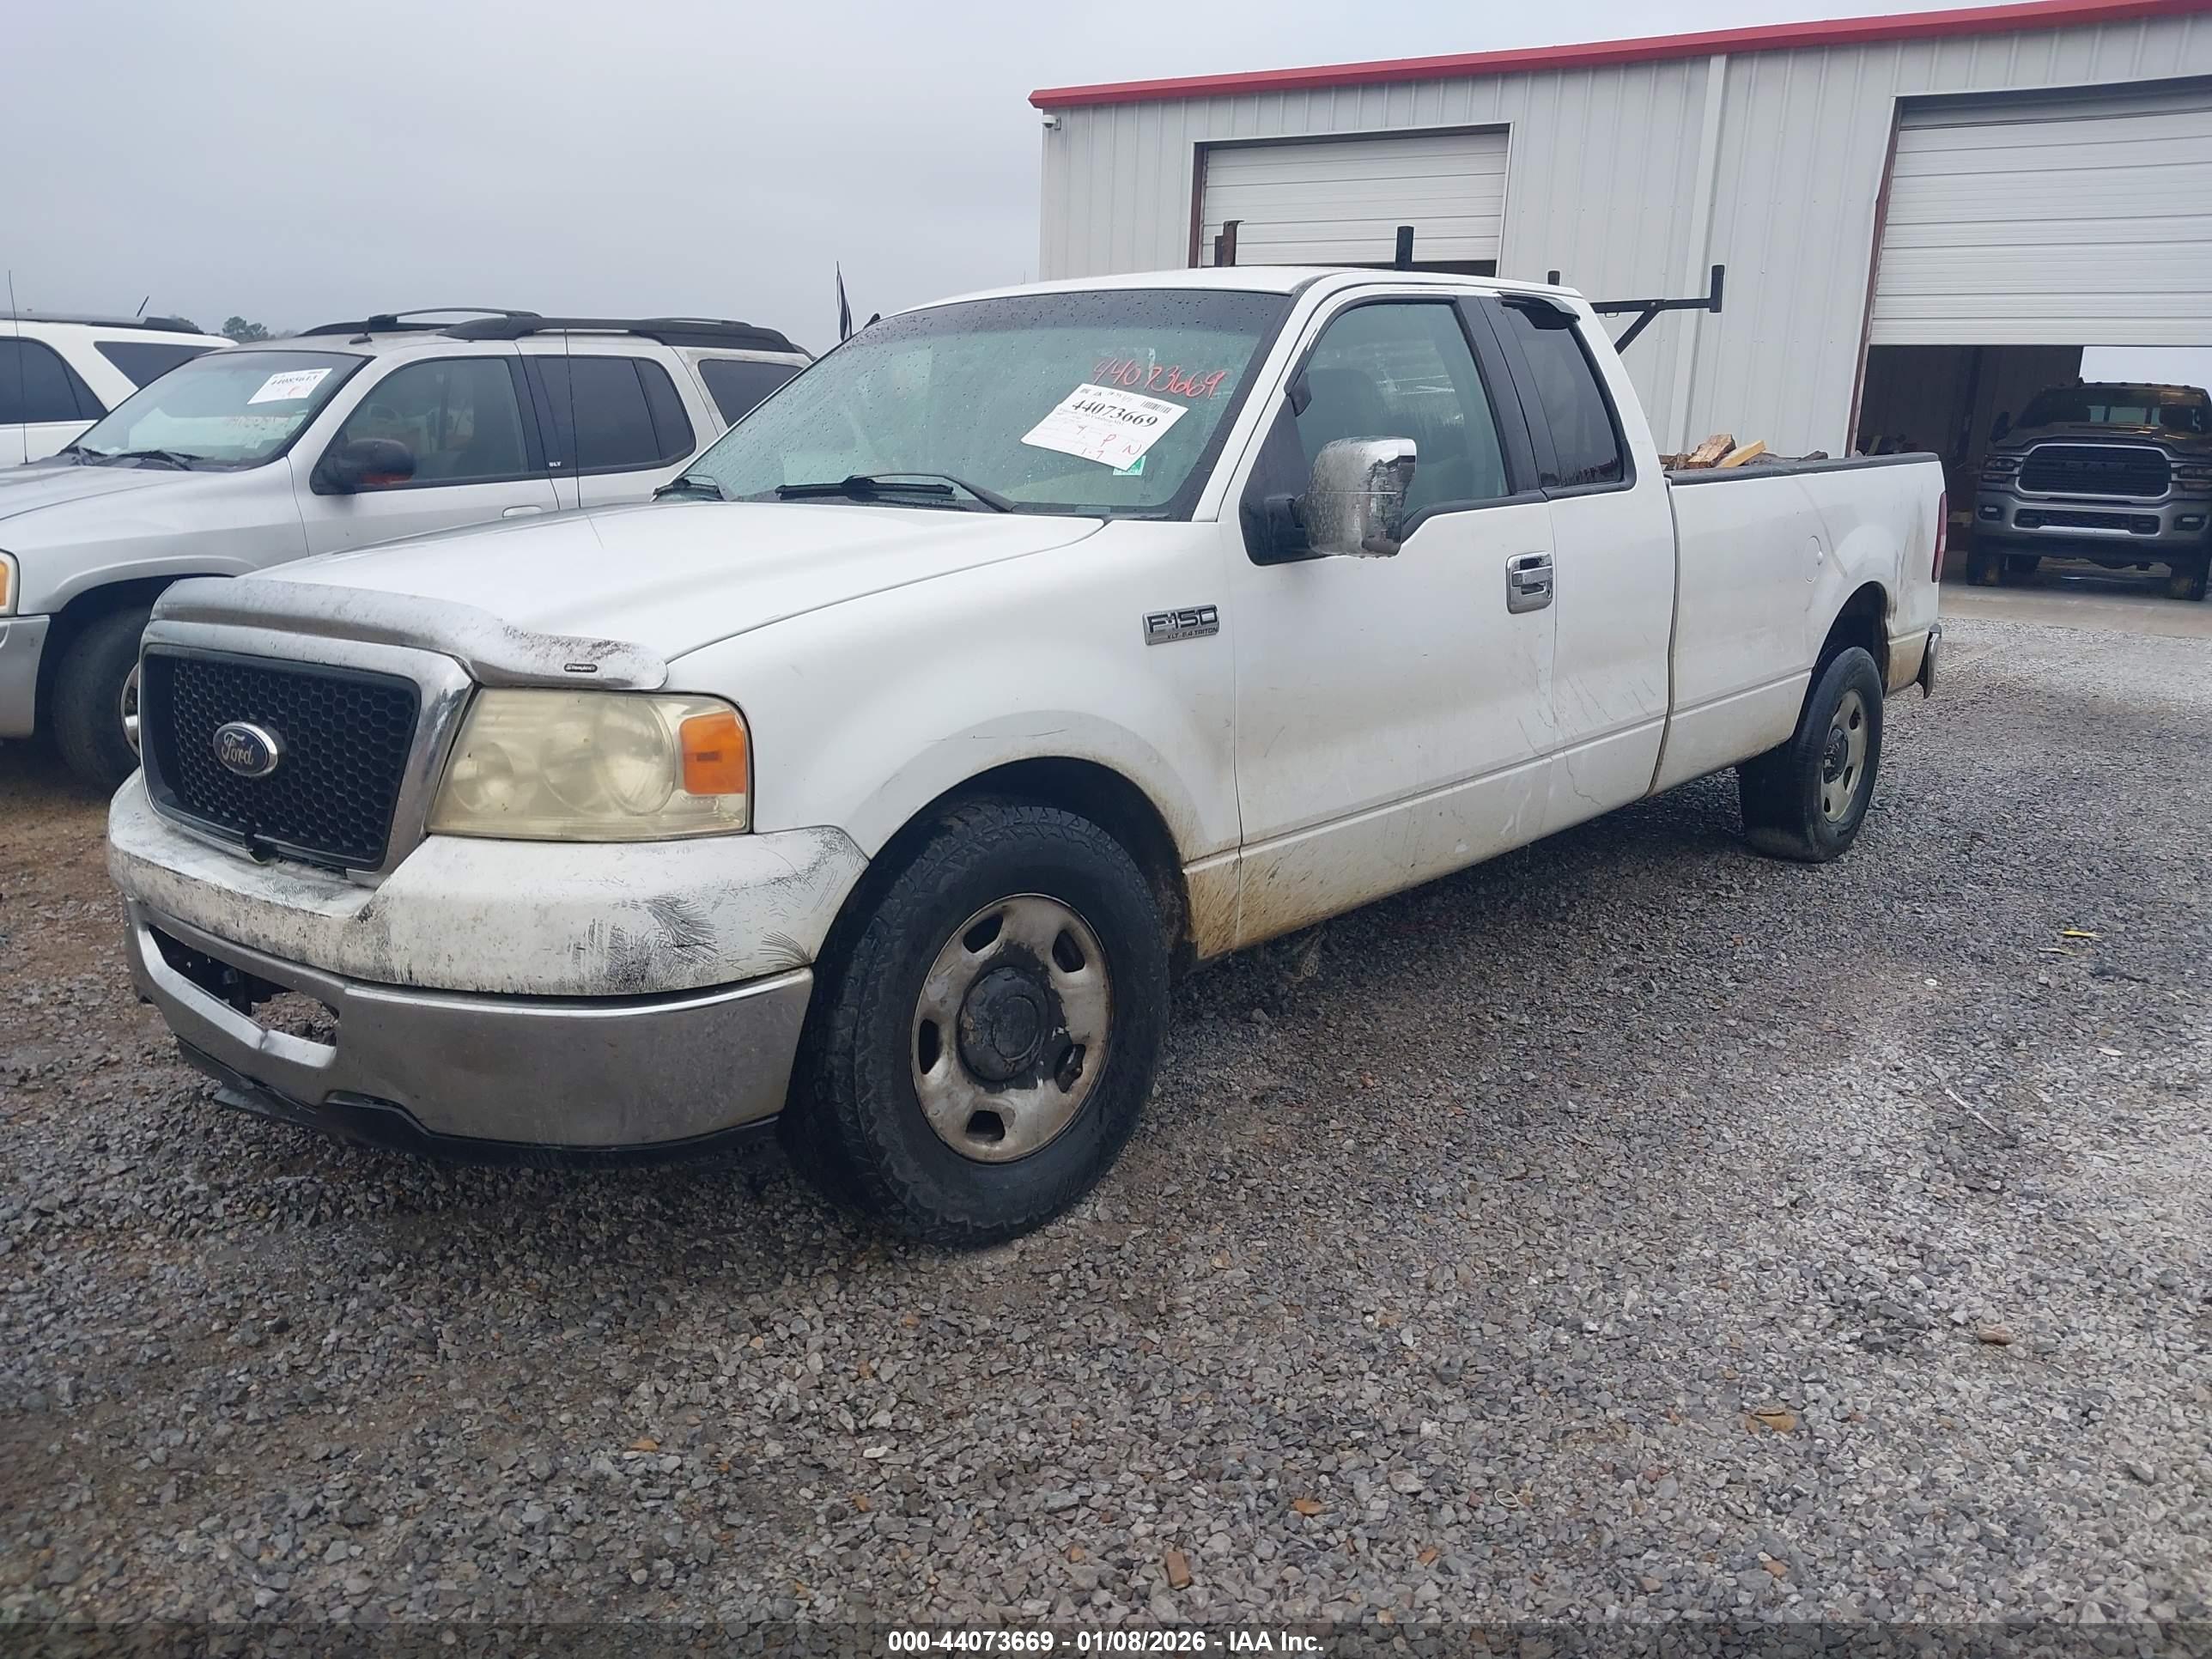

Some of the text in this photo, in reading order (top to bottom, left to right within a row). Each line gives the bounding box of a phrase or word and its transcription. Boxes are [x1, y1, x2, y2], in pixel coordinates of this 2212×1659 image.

[1093, 358, 1226, 398] 44073669
[1073, 398, 1158, 428] 44073669
[222, 732, 254, 765] Ford
